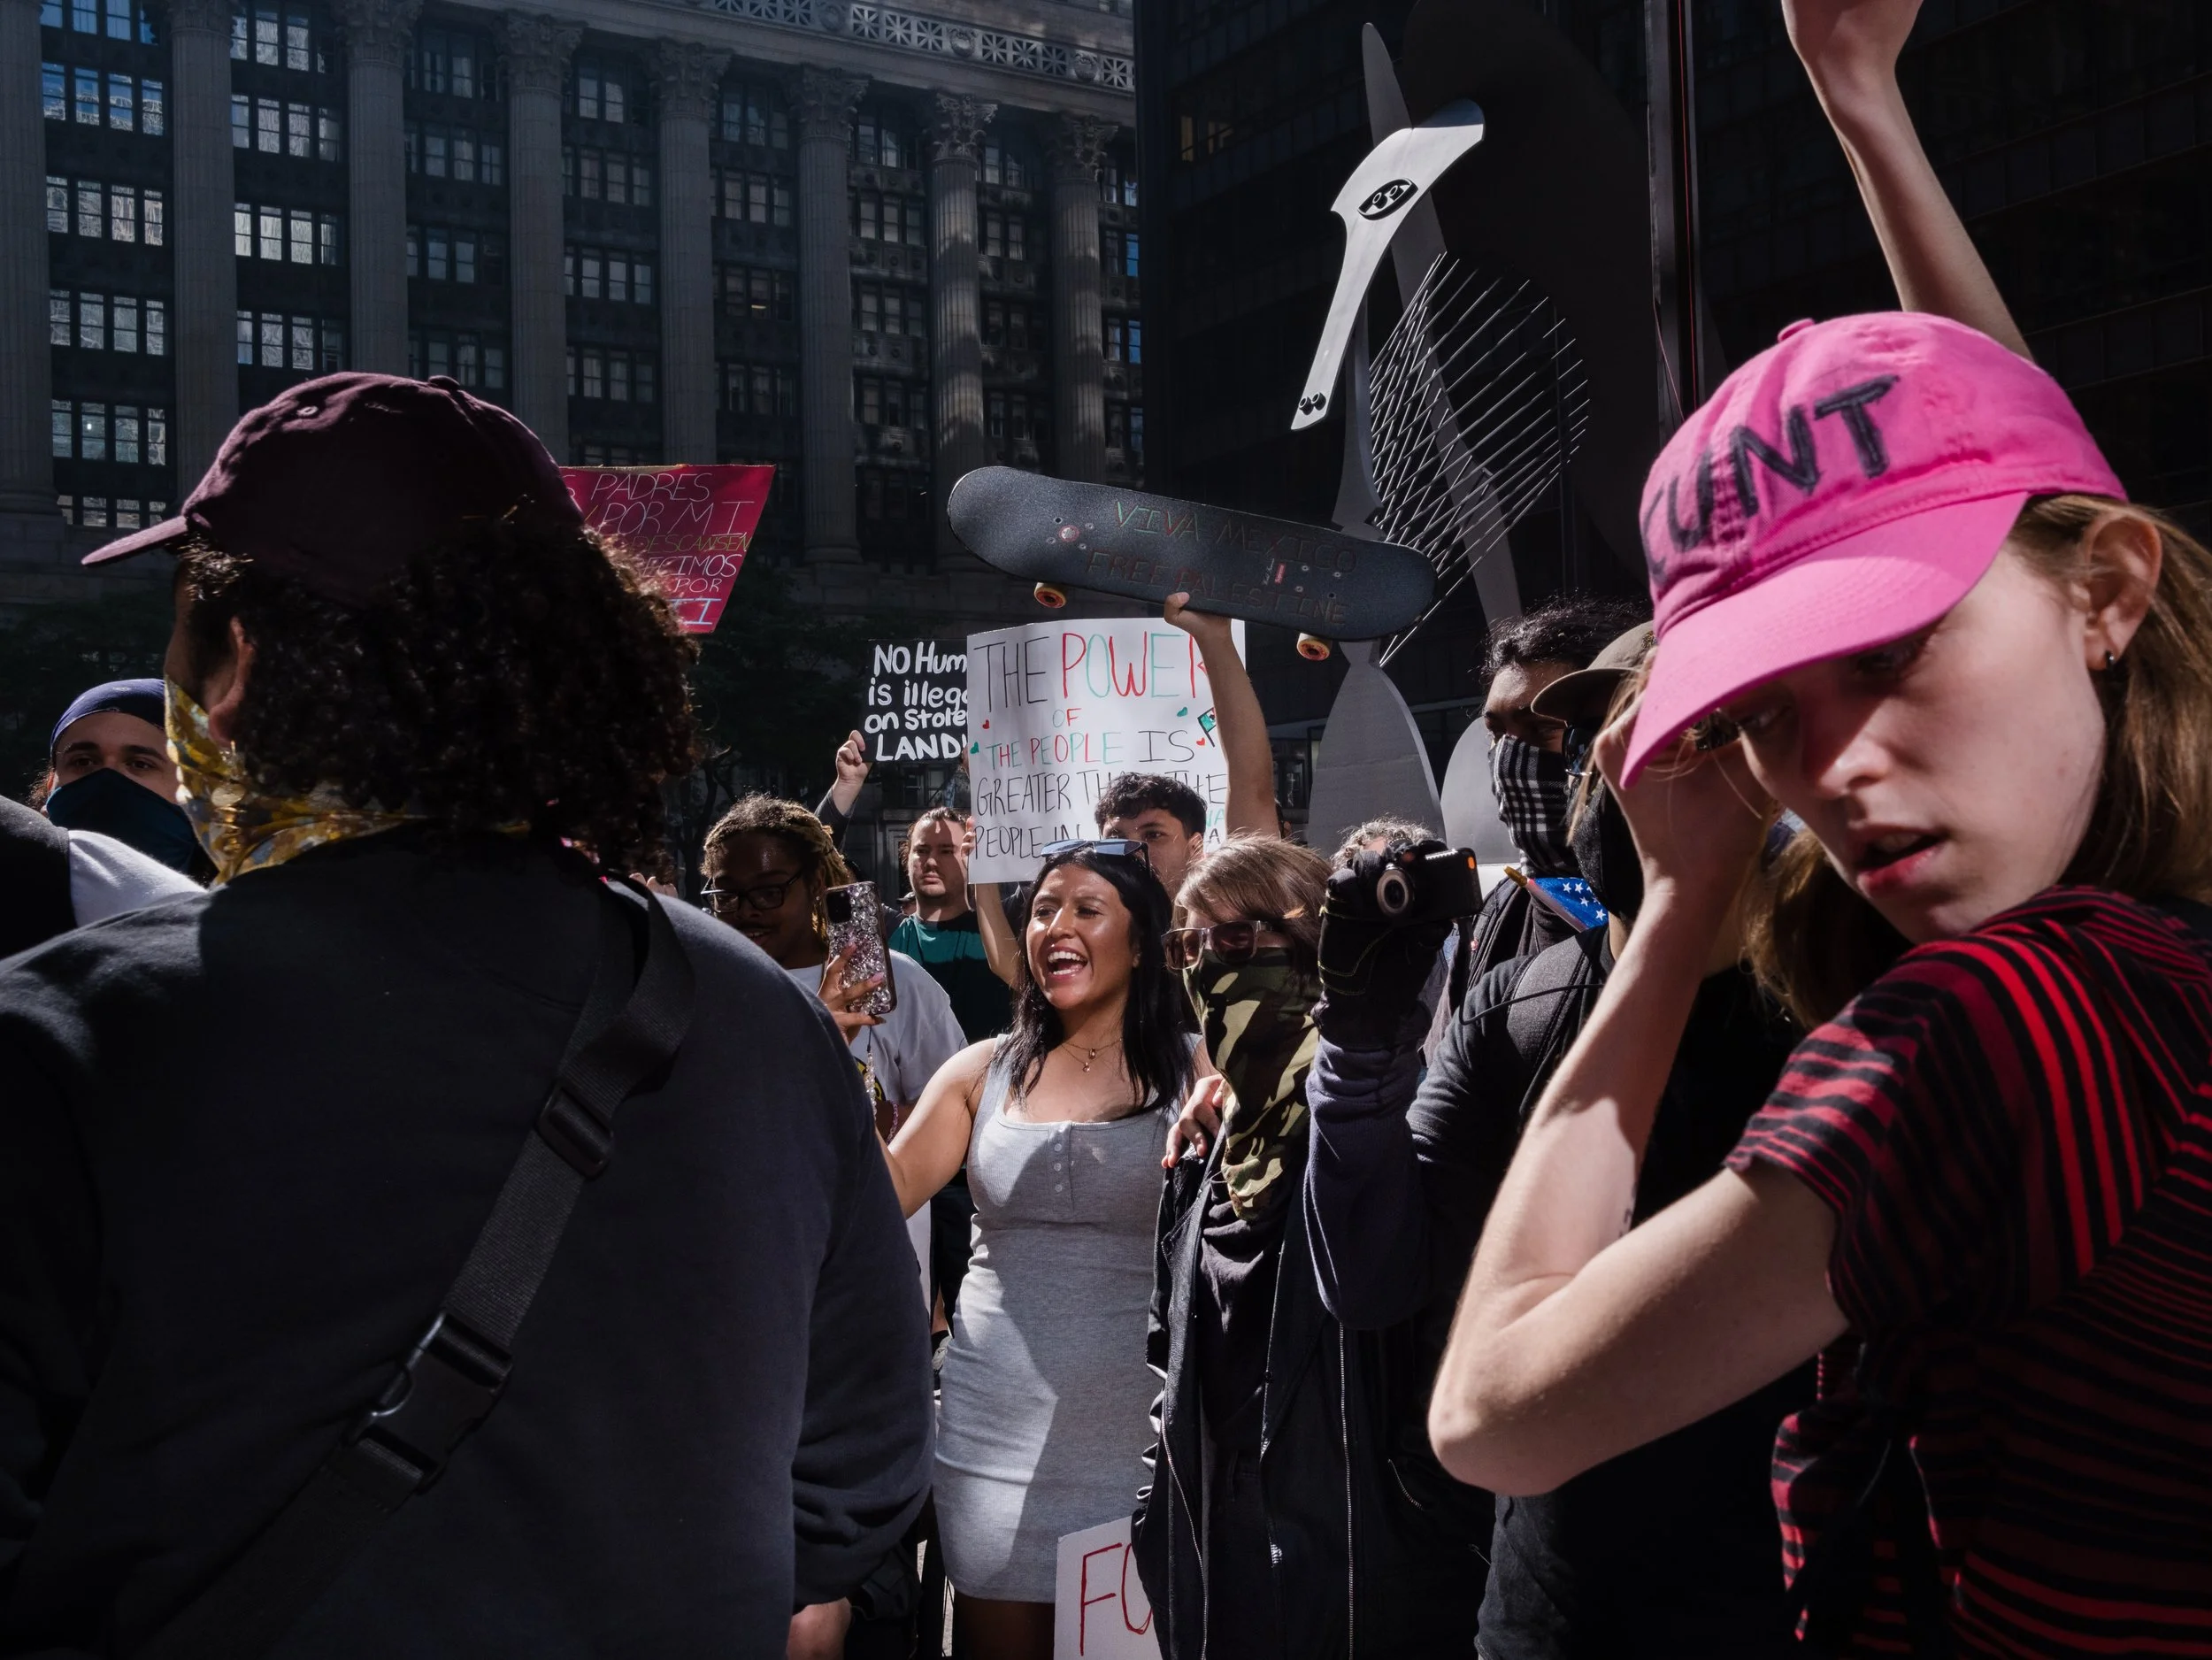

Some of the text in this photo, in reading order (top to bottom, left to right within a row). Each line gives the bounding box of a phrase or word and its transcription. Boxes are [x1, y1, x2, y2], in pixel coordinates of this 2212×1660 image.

[590, 473, 712, 503] PADRES
[598, 501, 664, 535] POR
[1115, 501, 1200, 542] VIVA
[1216, 519, 1357, 573] MEXICO
[672, 578, 722, 593] POR
[1086, 550, 1169, 588] FREE
[1175, 566, 1348, 626] PALESTINE
[873, 641, 967, 677] NO Hum
[974, 635, 1049, 712] THE
[868, 677, 968, 713] is illeg
[864, 707, 968, 734] on Stole
[1052, 708, 1081, 728] OF
[986, 730, 1194, 770] THE PEOPLE IS
[976, 765, 1071, 816] GREATER
[1076, 769, 1125, 806] TH
[972, 826, 1042, 860] PEOPLE
